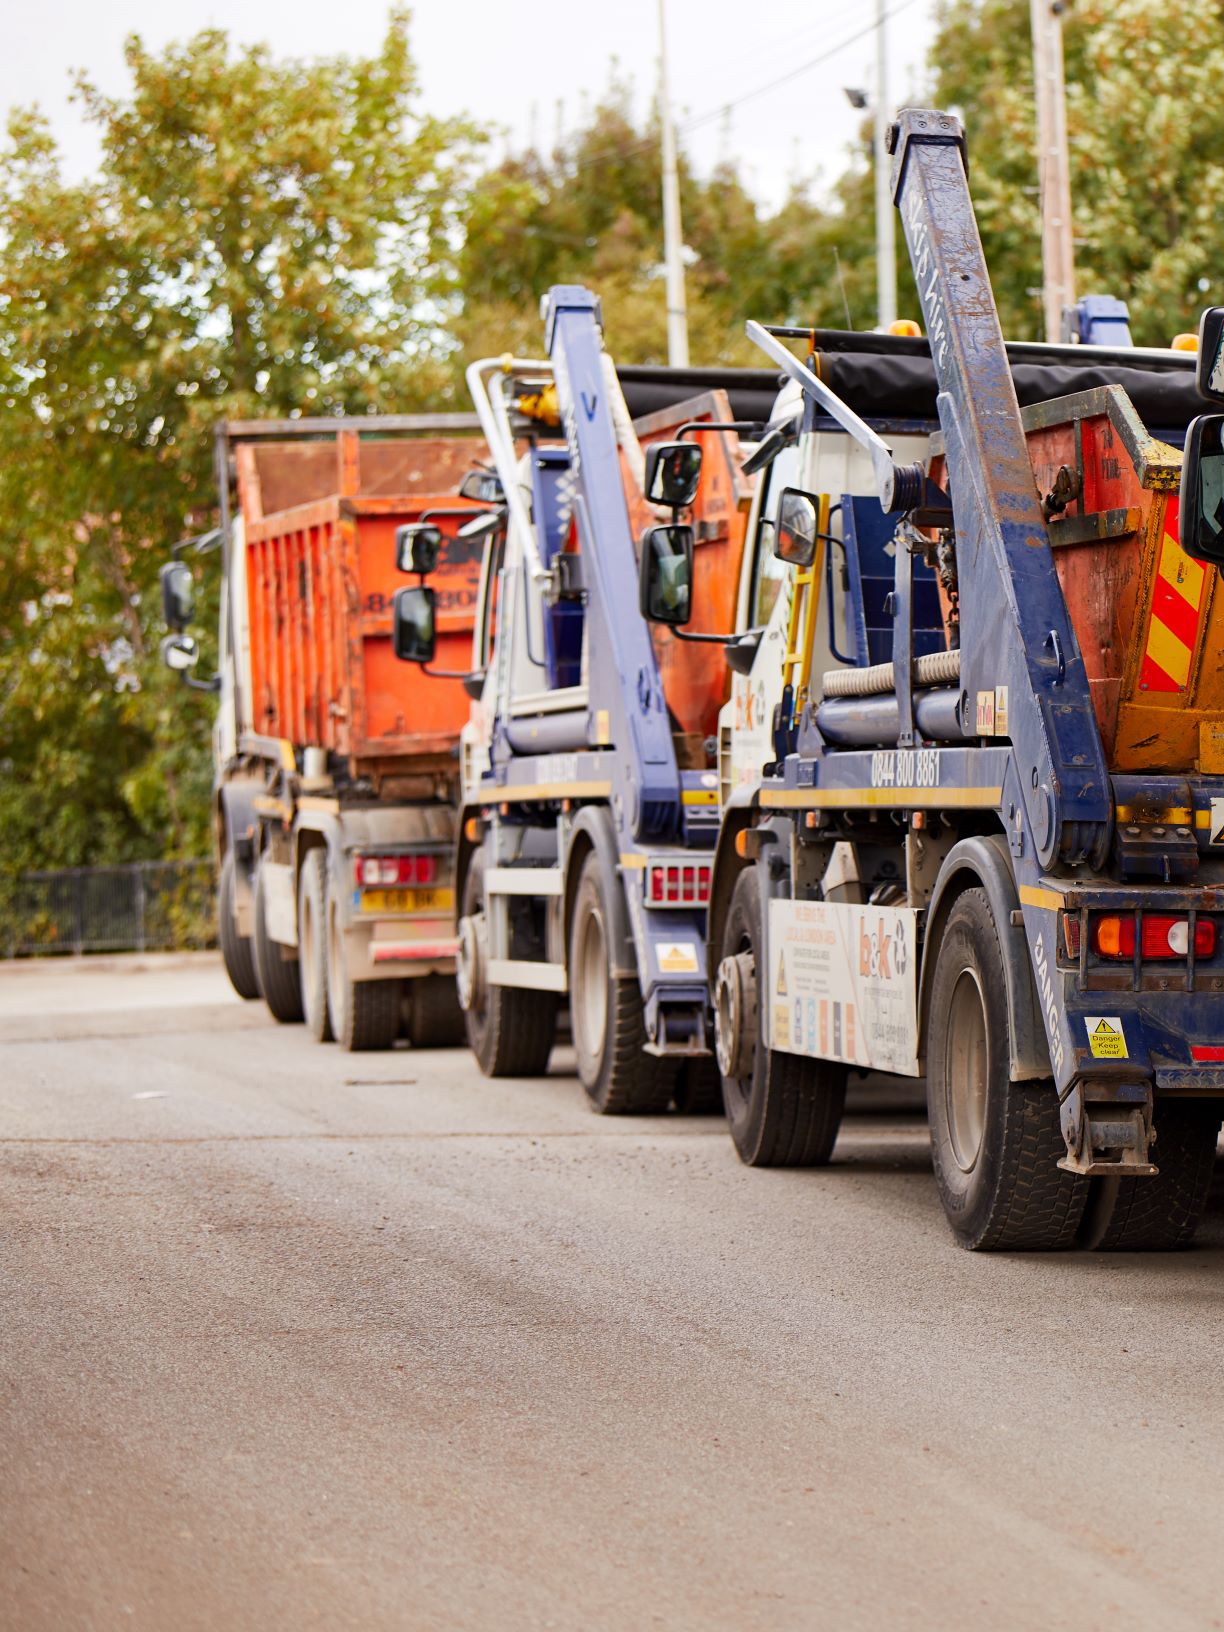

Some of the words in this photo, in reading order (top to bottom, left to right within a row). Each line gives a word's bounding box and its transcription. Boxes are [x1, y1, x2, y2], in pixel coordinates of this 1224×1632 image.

[871, 752, 895, 787] 0844
[896, 751, 915, 787] 800
[916, 750, 940, 787] 8861
[860, 916, 891, 980] b&k
[1034, 931, 1064, 1080] DANGER
[1092, 1035, 1121, 1043] Danger
